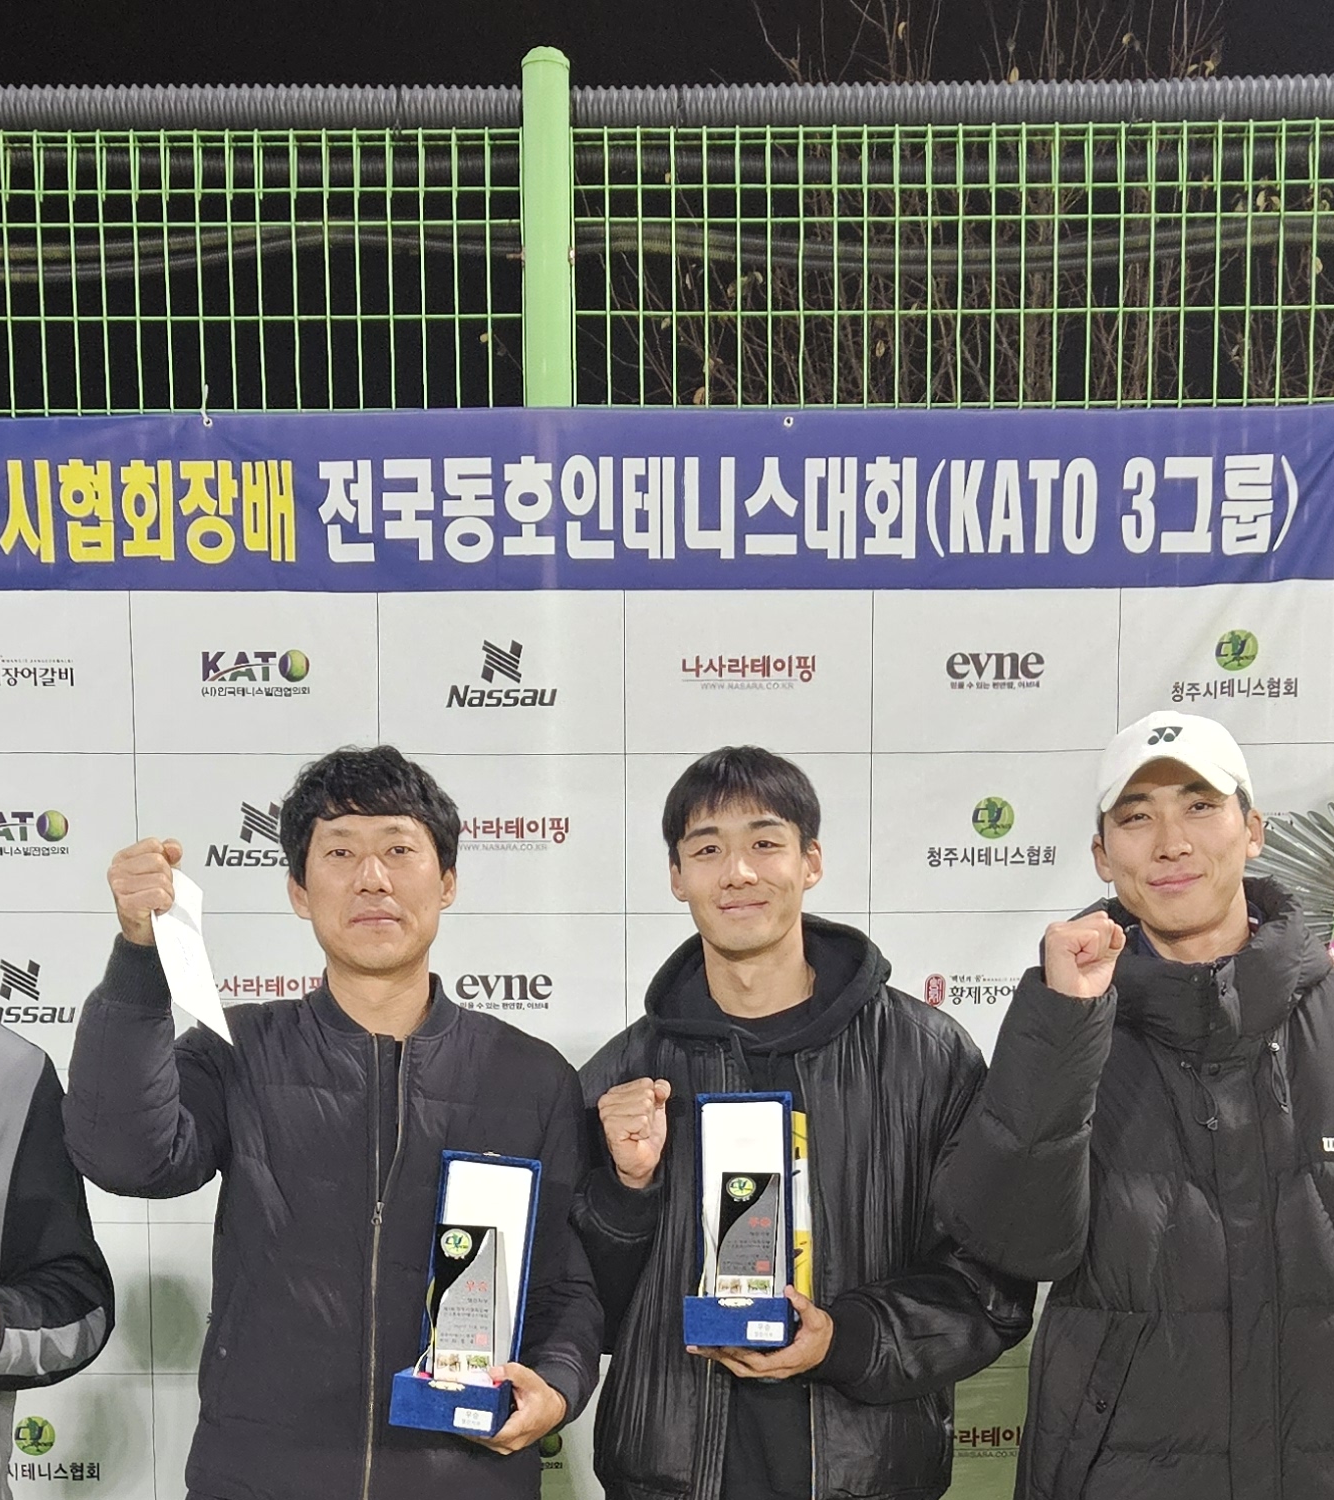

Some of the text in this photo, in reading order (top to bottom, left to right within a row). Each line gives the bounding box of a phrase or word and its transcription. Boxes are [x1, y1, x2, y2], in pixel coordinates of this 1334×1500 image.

[317, 453, 1098, 563] 전국동호인테니스대회(KATO
[1121, 452, 1300, 557] 3그룹)
[682, 655, 817, 683] 나사라테이핑
[945, 651, 1045, 681] evne
[445, 684, 557, 708] Nassau
[1171, 677, 1298, 702] 청주시테니스협회
[459, 816, 569, 844] 사라테이핑
[205, 844, 290, 867] Nassa
[926, 845, 1056, 868] 청주시테니스협회
[213, 975, 323, 997] 사라테이
[455, 973, 552, 1000] evne
[949, 985, 1016, 1004] 황제장어
[954, 1426, 1021, 1447] 라테이
[7, 1461, 101, 1481] 시테니스협회
